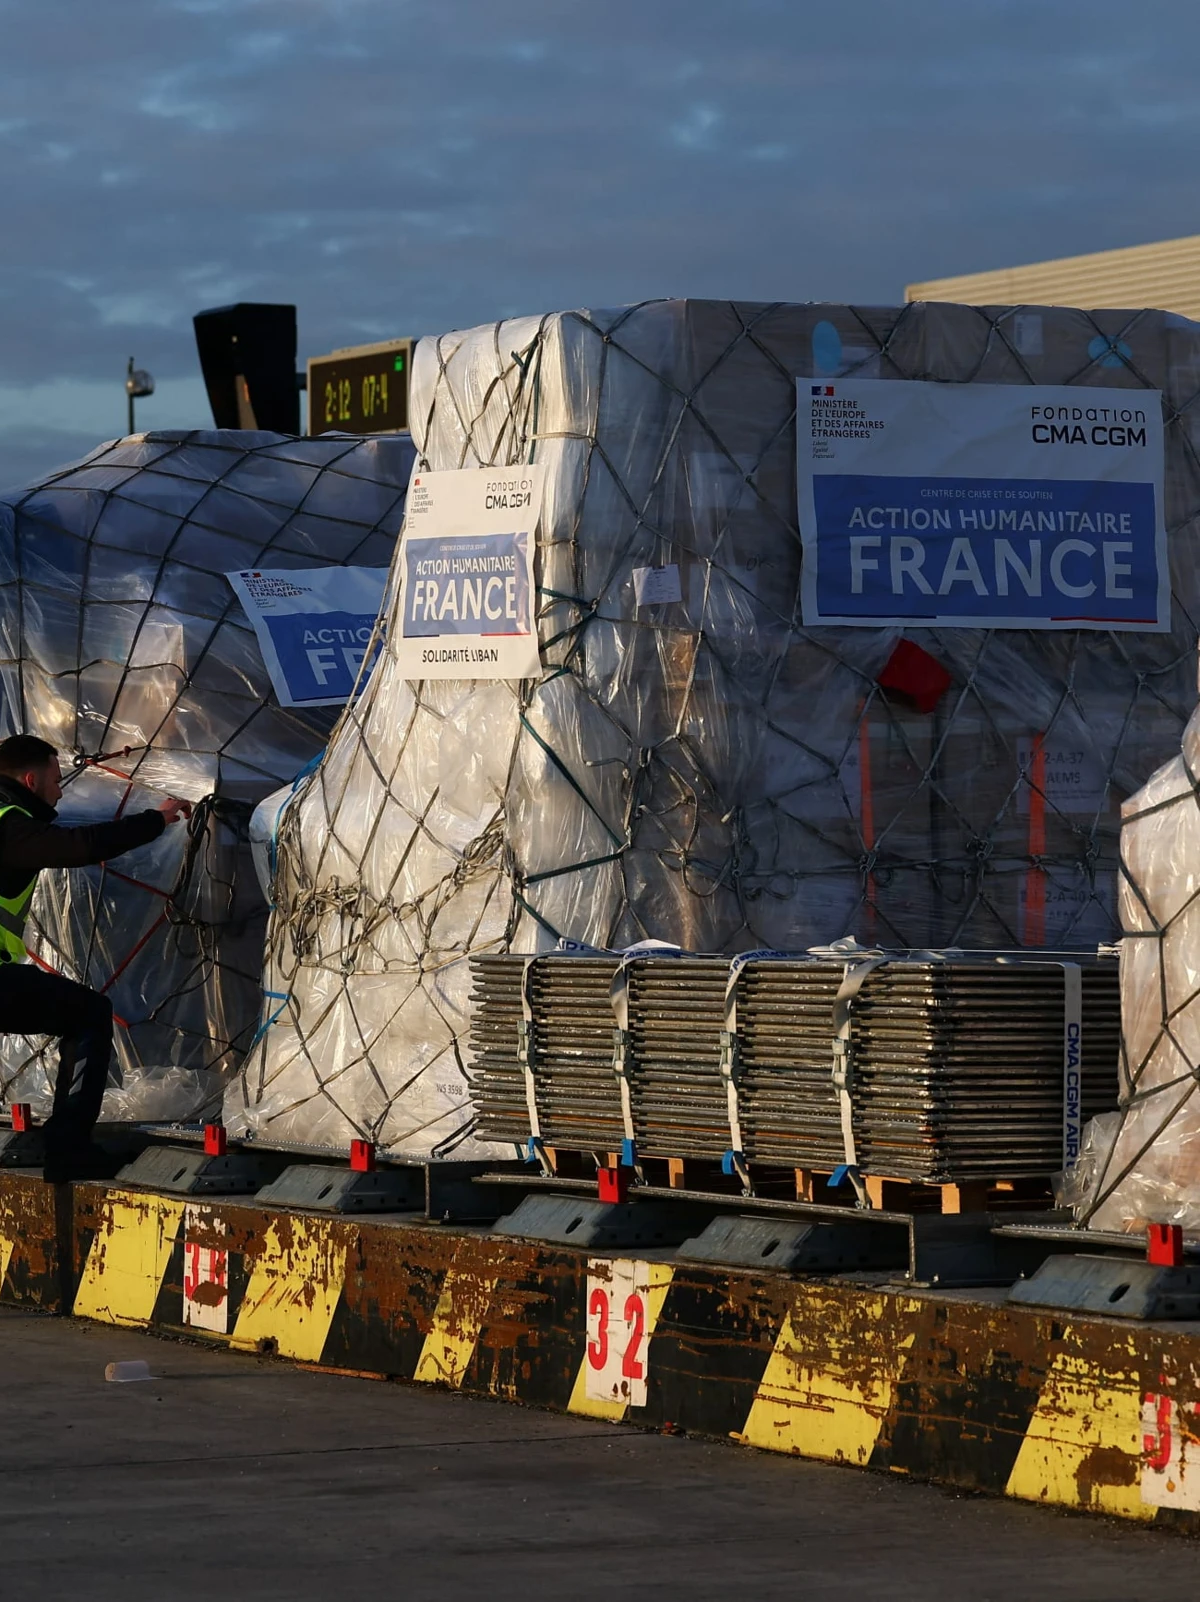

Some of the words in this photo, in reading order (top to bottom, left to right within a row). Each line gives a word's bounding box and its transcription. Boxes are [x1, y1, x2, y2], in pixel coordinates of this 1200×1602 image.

[811, 399, 858, 409] MINISTÈRE
[811, 409, 823, 417] DE
[825, 409, 866, 418] L'EUROPE
[811, 419, 822, 427] ET
[825, 420, 841, 428] DES
[844, 421, 884, 429] AFFAIRES
[811, 428, 870, 438] ÉTRANGÈRES
[1032, 424, 1087, 445] CMA
[1091, 427, 1146, 447] CGM
[485, 495, 508, 510] CMA
[920, 489, 954, 498] CENTRE
[955, 489, 966, 498] DE
[968, 489, 992, 498] CRISE
[993, 490, 1003, 499] ET
[1005, 490, 1016, 499] DE
[1018, 490, 1053, 500] SOUTIEN
[848, 507, 952, 530] ACTION
[960, 509, 1132, 534] HUMANITAIRE
[416, 559, 450, 575] ACTION
[452, 555, 516, 574] HUMANITAIRE
[849, 535, 1134, 599] FRANCE
[411, 576, 517, 621] FRANCE
[303, 627, 373, 645] ACTIO
[422, 646, 470, 663] SOLIDARITÉ
[471, 649, 499, 662] LIBAN
[1067, 1023, 1079, 1069] CMA
[1066, 1072, 1079, 1118] CGM
[1066, 1122, 1078, 1158] AIR
[588, 1288, 644, 1379] 32
